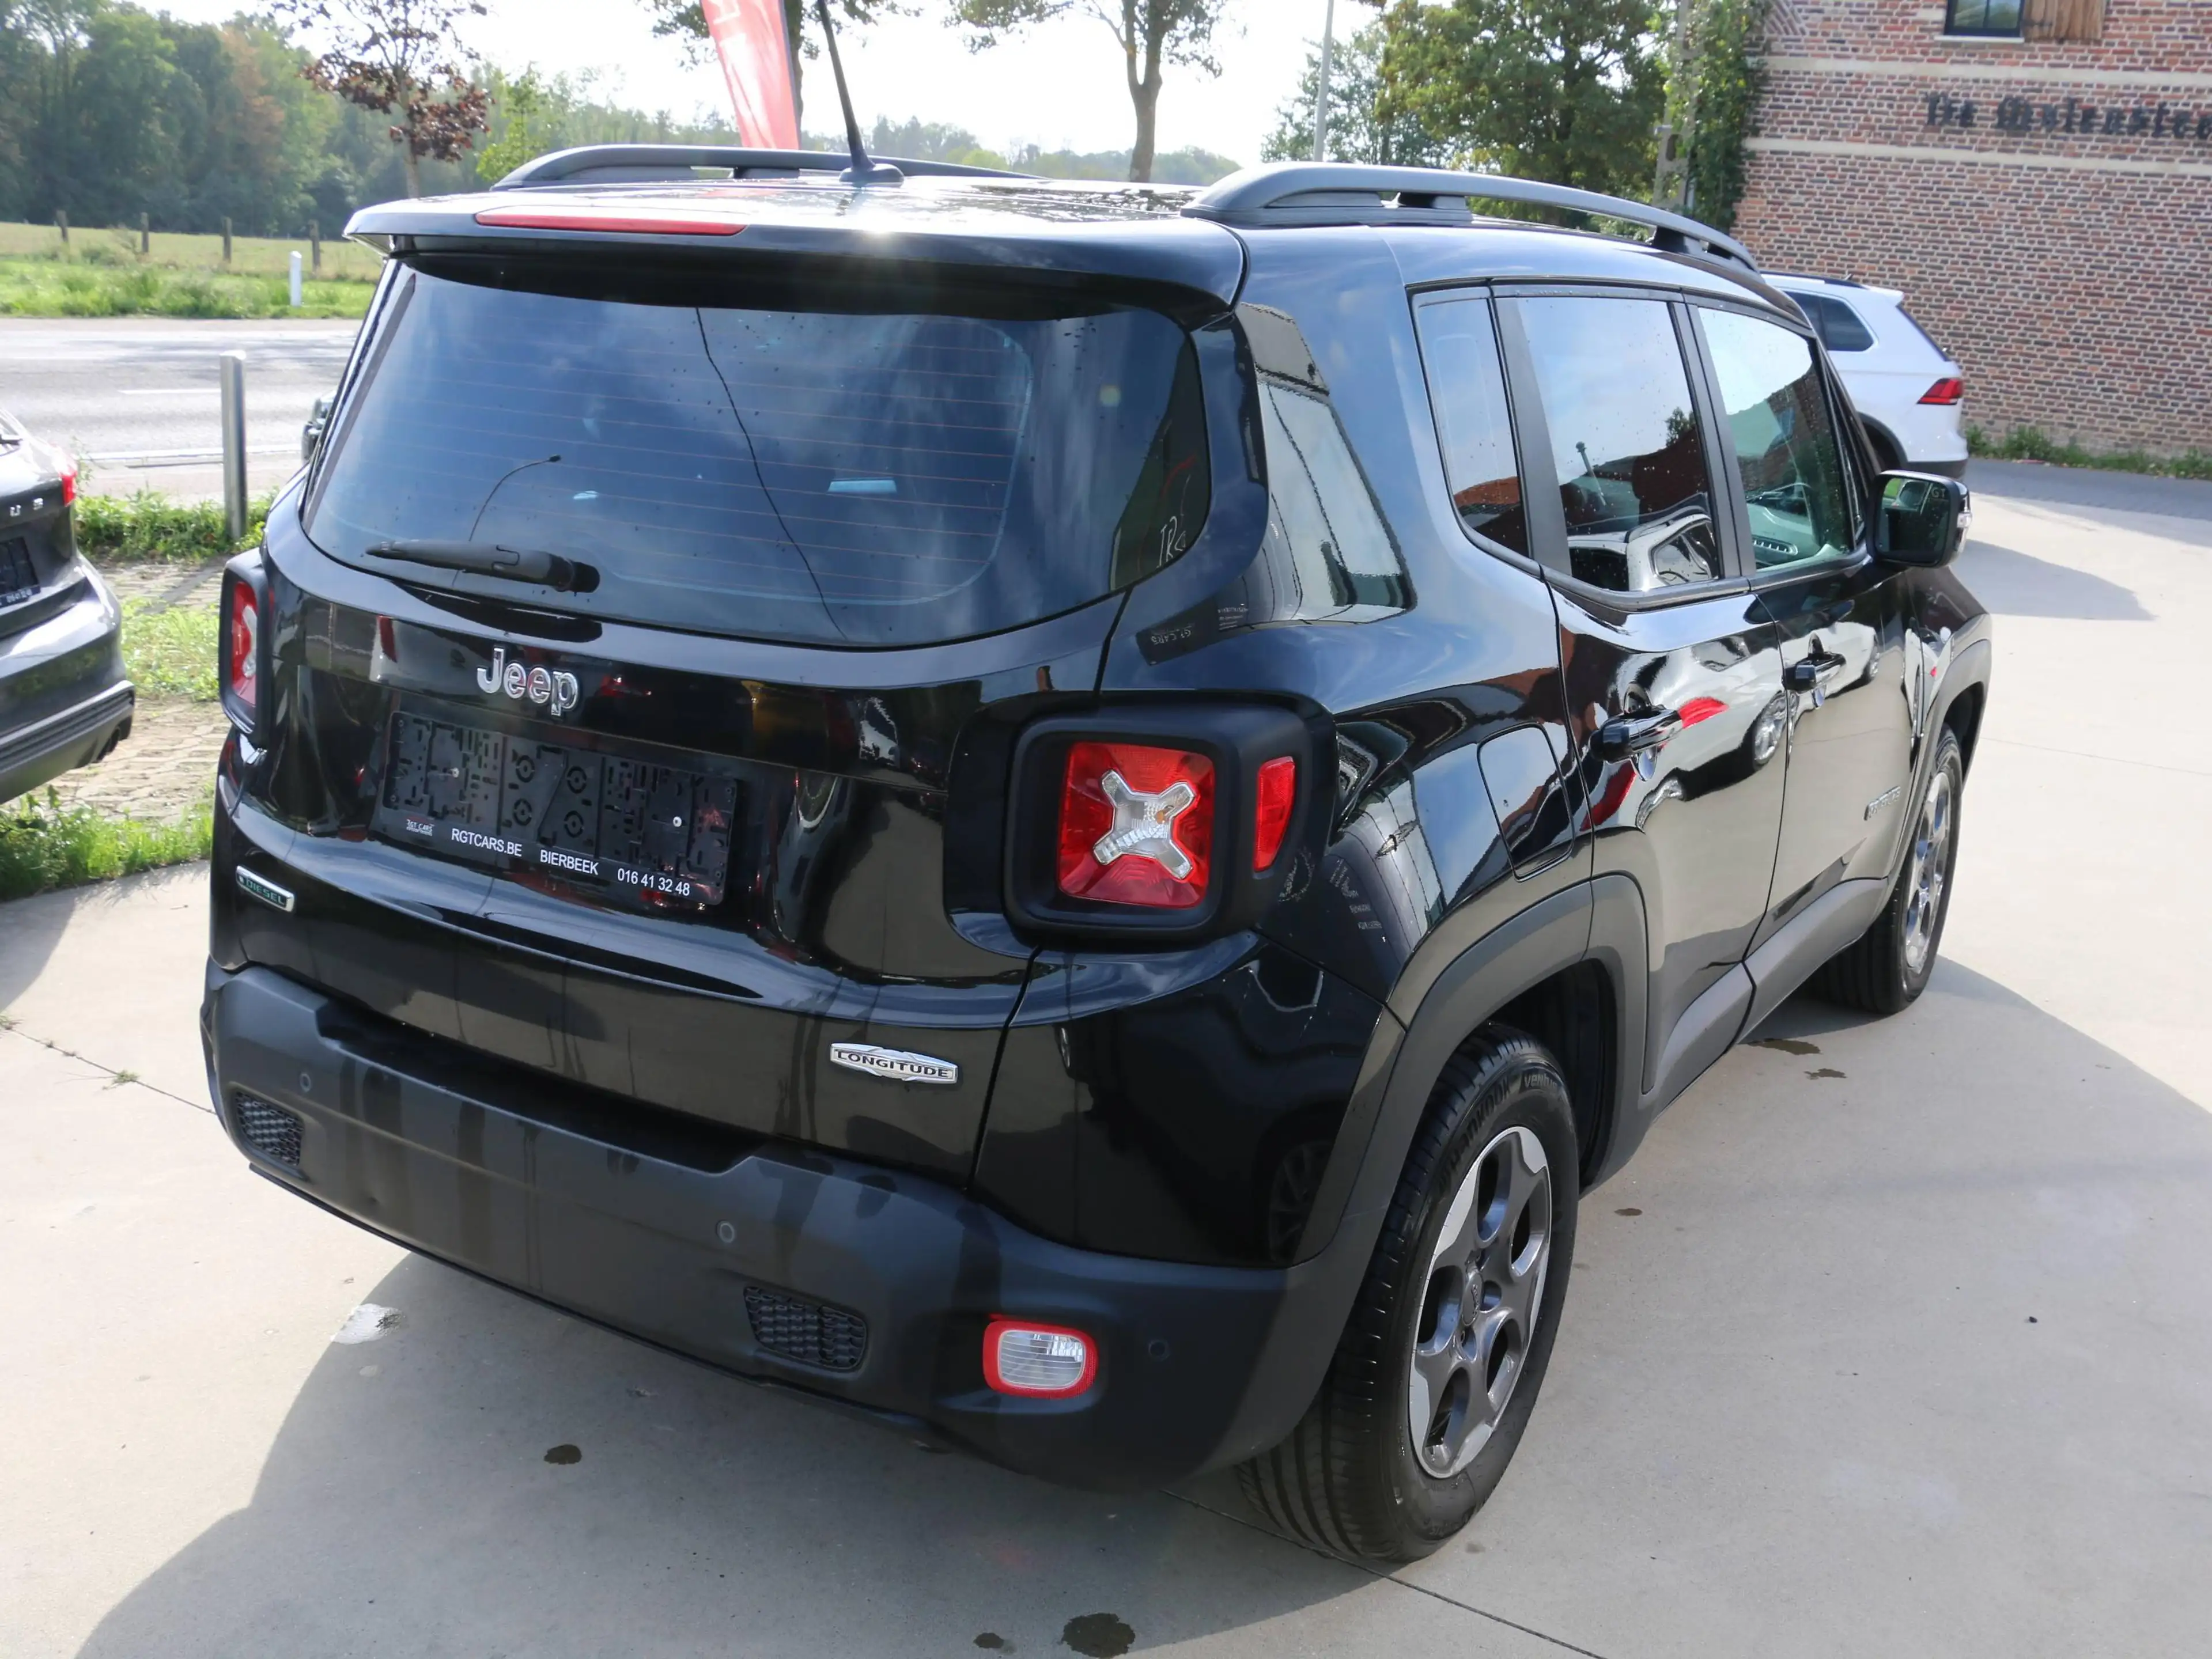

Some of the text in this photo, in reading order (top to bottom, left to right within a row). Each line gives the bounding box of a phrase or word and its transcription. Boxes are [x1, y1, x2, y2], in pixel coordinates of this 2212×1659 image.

[477, 647, 578, 717] Jeep
[451, 828, 523, 857] RGTCARS.BE
[540, 850, 599, 876] BIERBEEK
[618, 868, 638, 885] 016
[641, 873, 654, 888] 41
[658, 877, 672, 892] 32
[675, 881, 690, 896] 48
[837, 1050, 949, 1078] LONGITUDE
